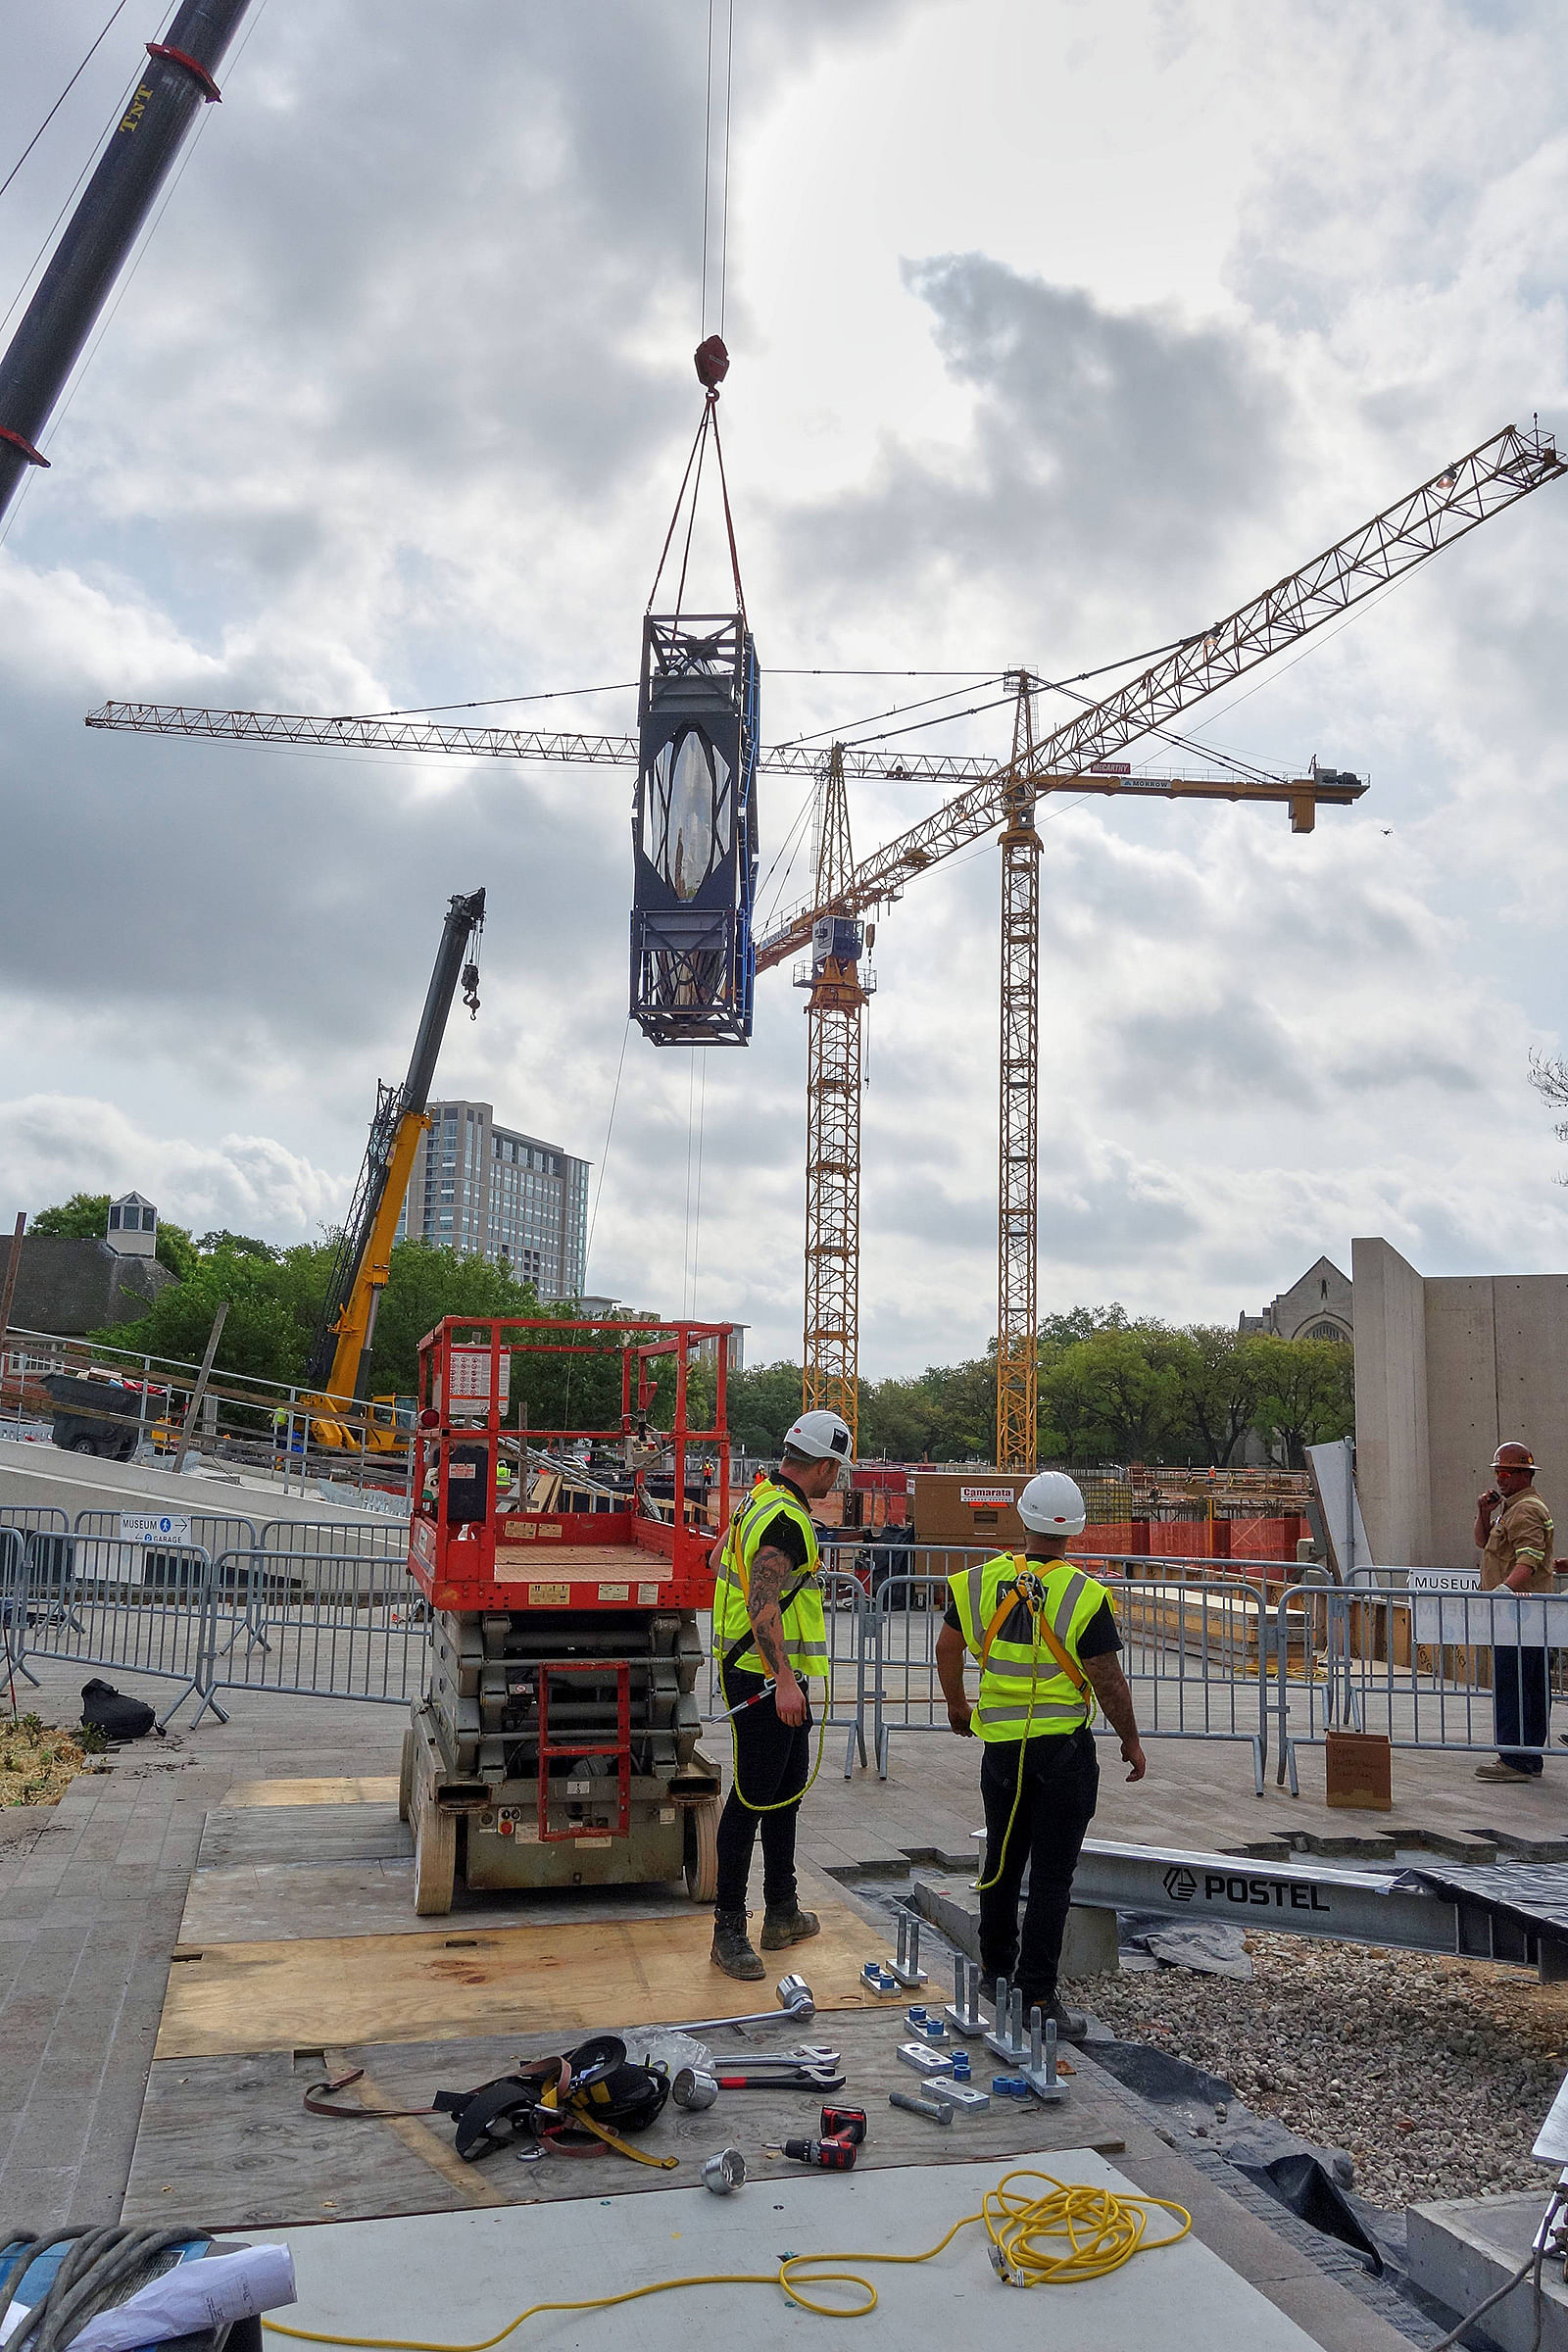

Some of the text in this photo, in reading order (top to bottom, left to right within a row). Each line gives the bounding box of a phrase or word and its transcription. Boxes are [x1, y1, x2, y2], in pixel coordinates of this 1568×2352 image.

[119, 82, 154, 132] TNT
[963, 1488, 1011, 1496] Camarata
[122, 1519, 157, 1530] MUSEUM
[1414, 1576, 1481, 1592] MUSEUM
[1204, 1875, 1331, 1912] POSTEL
